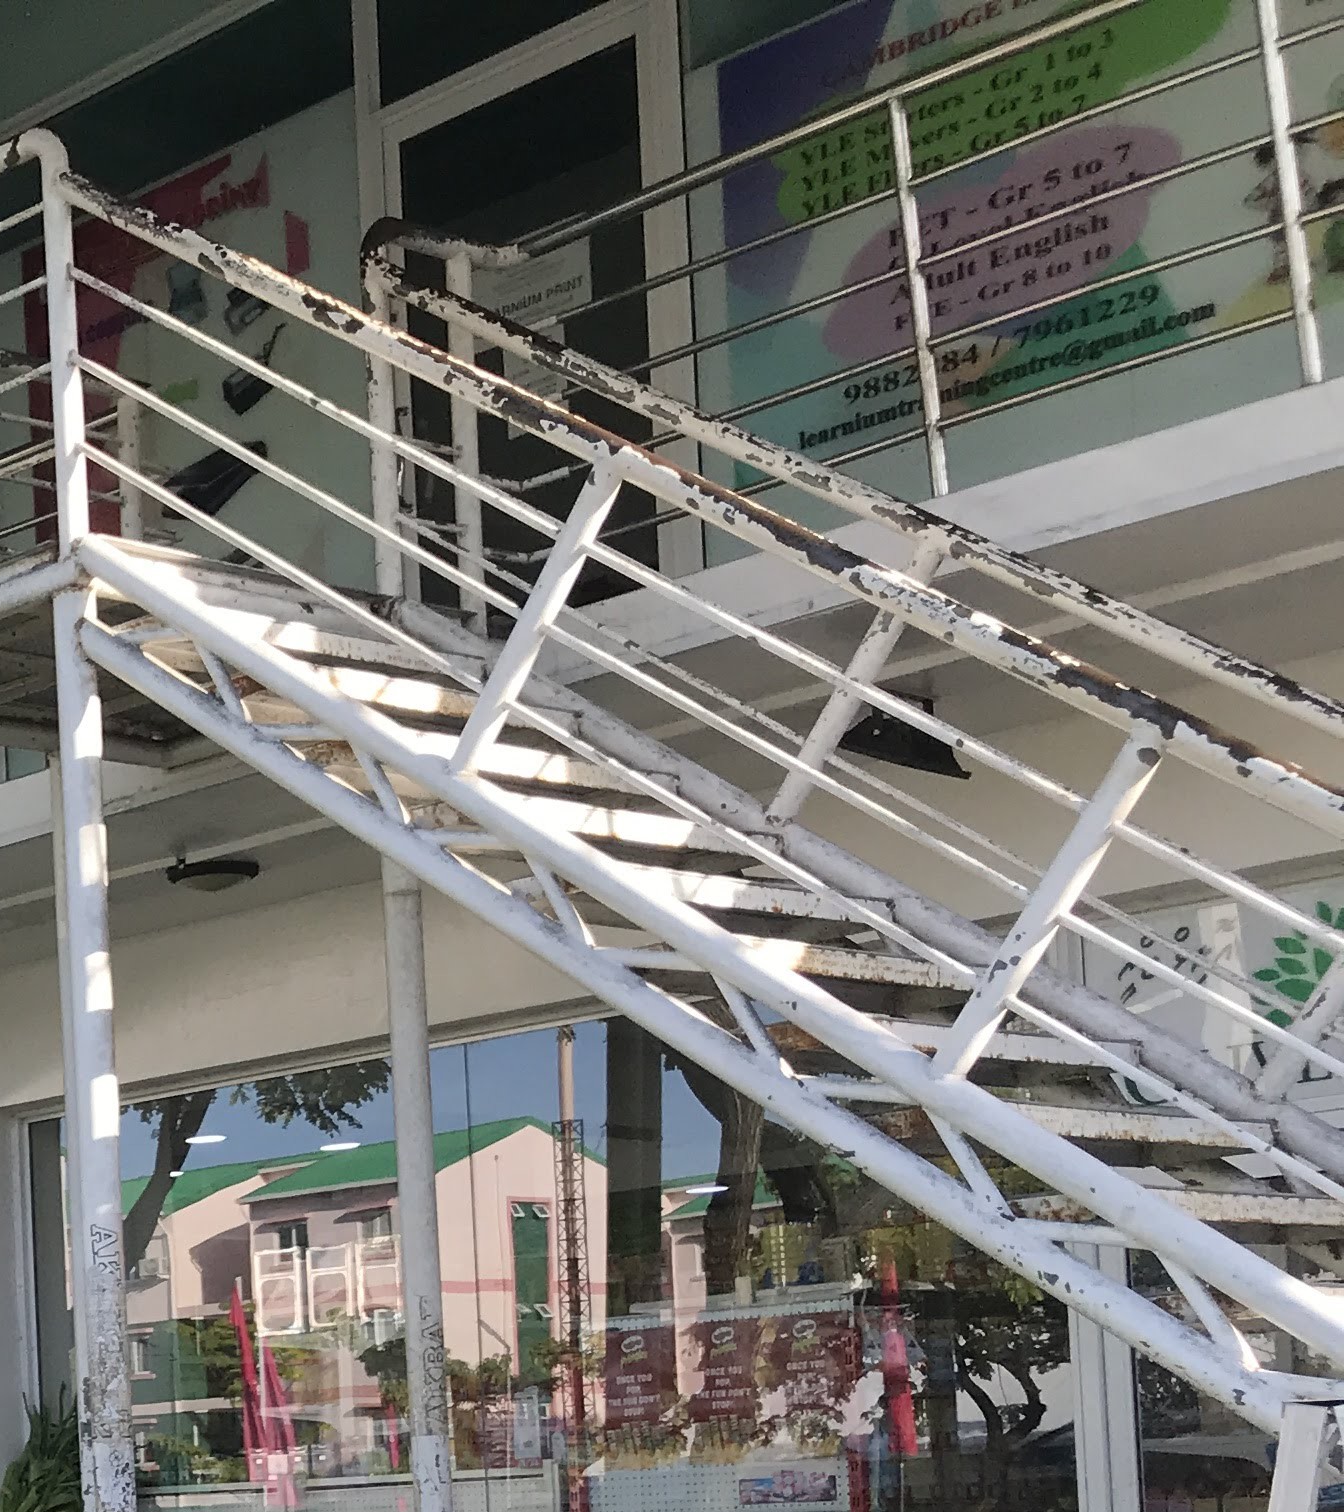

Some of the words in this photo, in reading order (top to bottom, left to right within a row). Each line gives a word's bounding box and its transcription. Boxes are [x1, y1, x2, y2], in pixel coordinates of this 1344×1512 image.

[863, 94, 968, 143] Stters
[988, 66, 1027, 94] Gr
[1065, 41, 1092, 61] to
[983, 94, 1024, 123] Gr
[1052, 71, 1080, 92] to
[969, 126, 1010, 153] Gr
[987, 179, 1034, 208] Gr
[1041, 169, 1062, 192] 5
[1071, 158, 1105, 182] to
[1113, 141, 1135, 166] 7
[989, 213, 1111, 269] English
[977, 273, 1018, 303] Gr
[1044, 255, 1073, 279] to
[1083, 243, 1114, 271] 10
[842, 340, 980, 404] 988284
